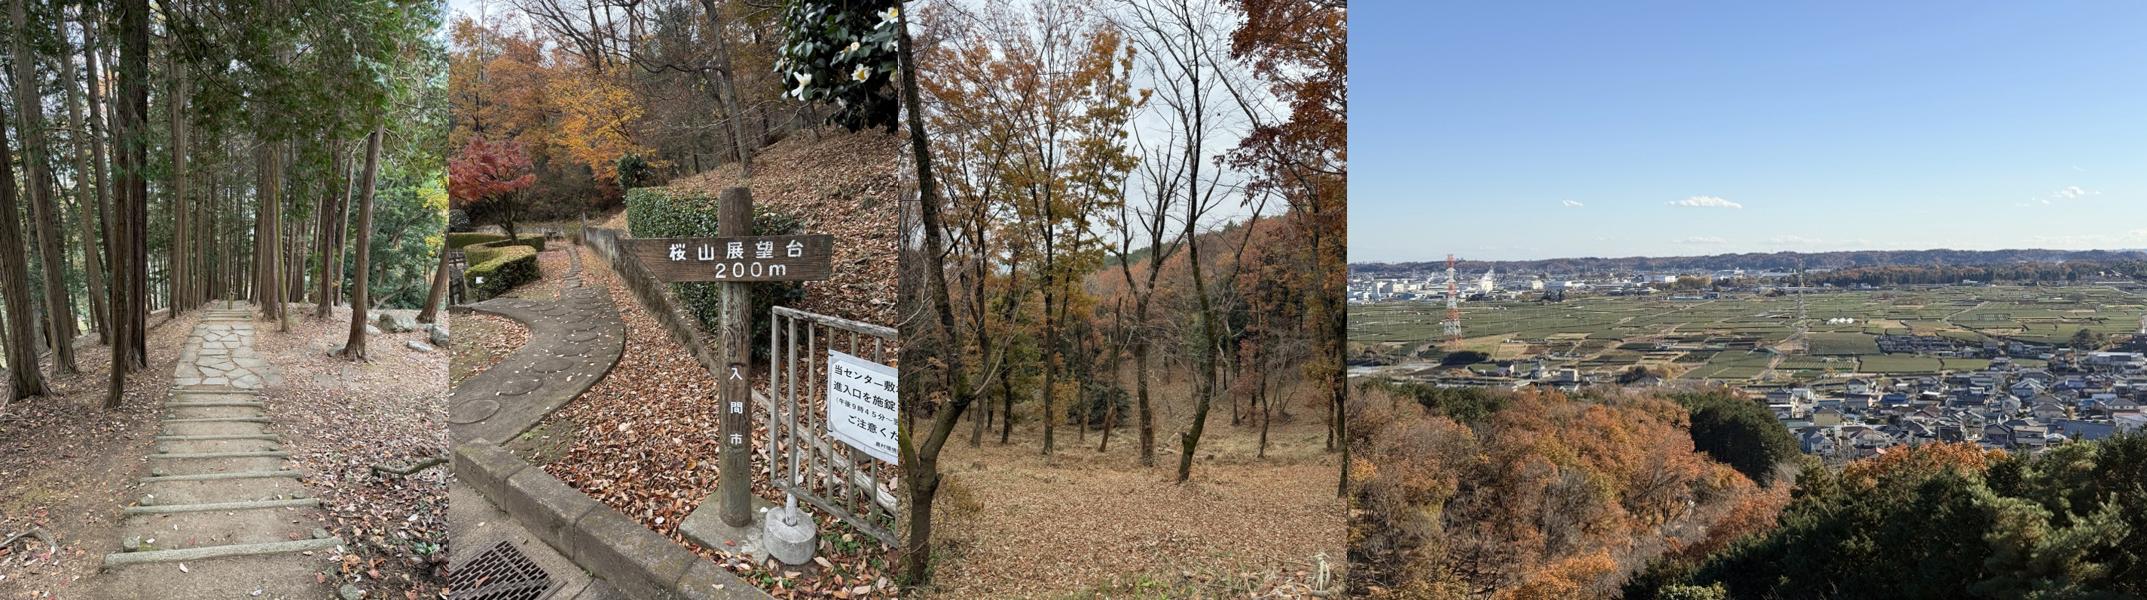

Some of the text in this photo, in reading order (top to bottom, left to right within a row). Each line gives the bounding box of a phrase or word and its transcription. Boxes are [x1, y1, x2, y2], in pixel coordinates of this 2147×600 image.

[669, 240, 804, 261] 桜山展望台
[715, 262, 786, 278] 200m
[729, 367, 743, 446] 入間市
[833, 380, 896, 412] 進入口を施錠
